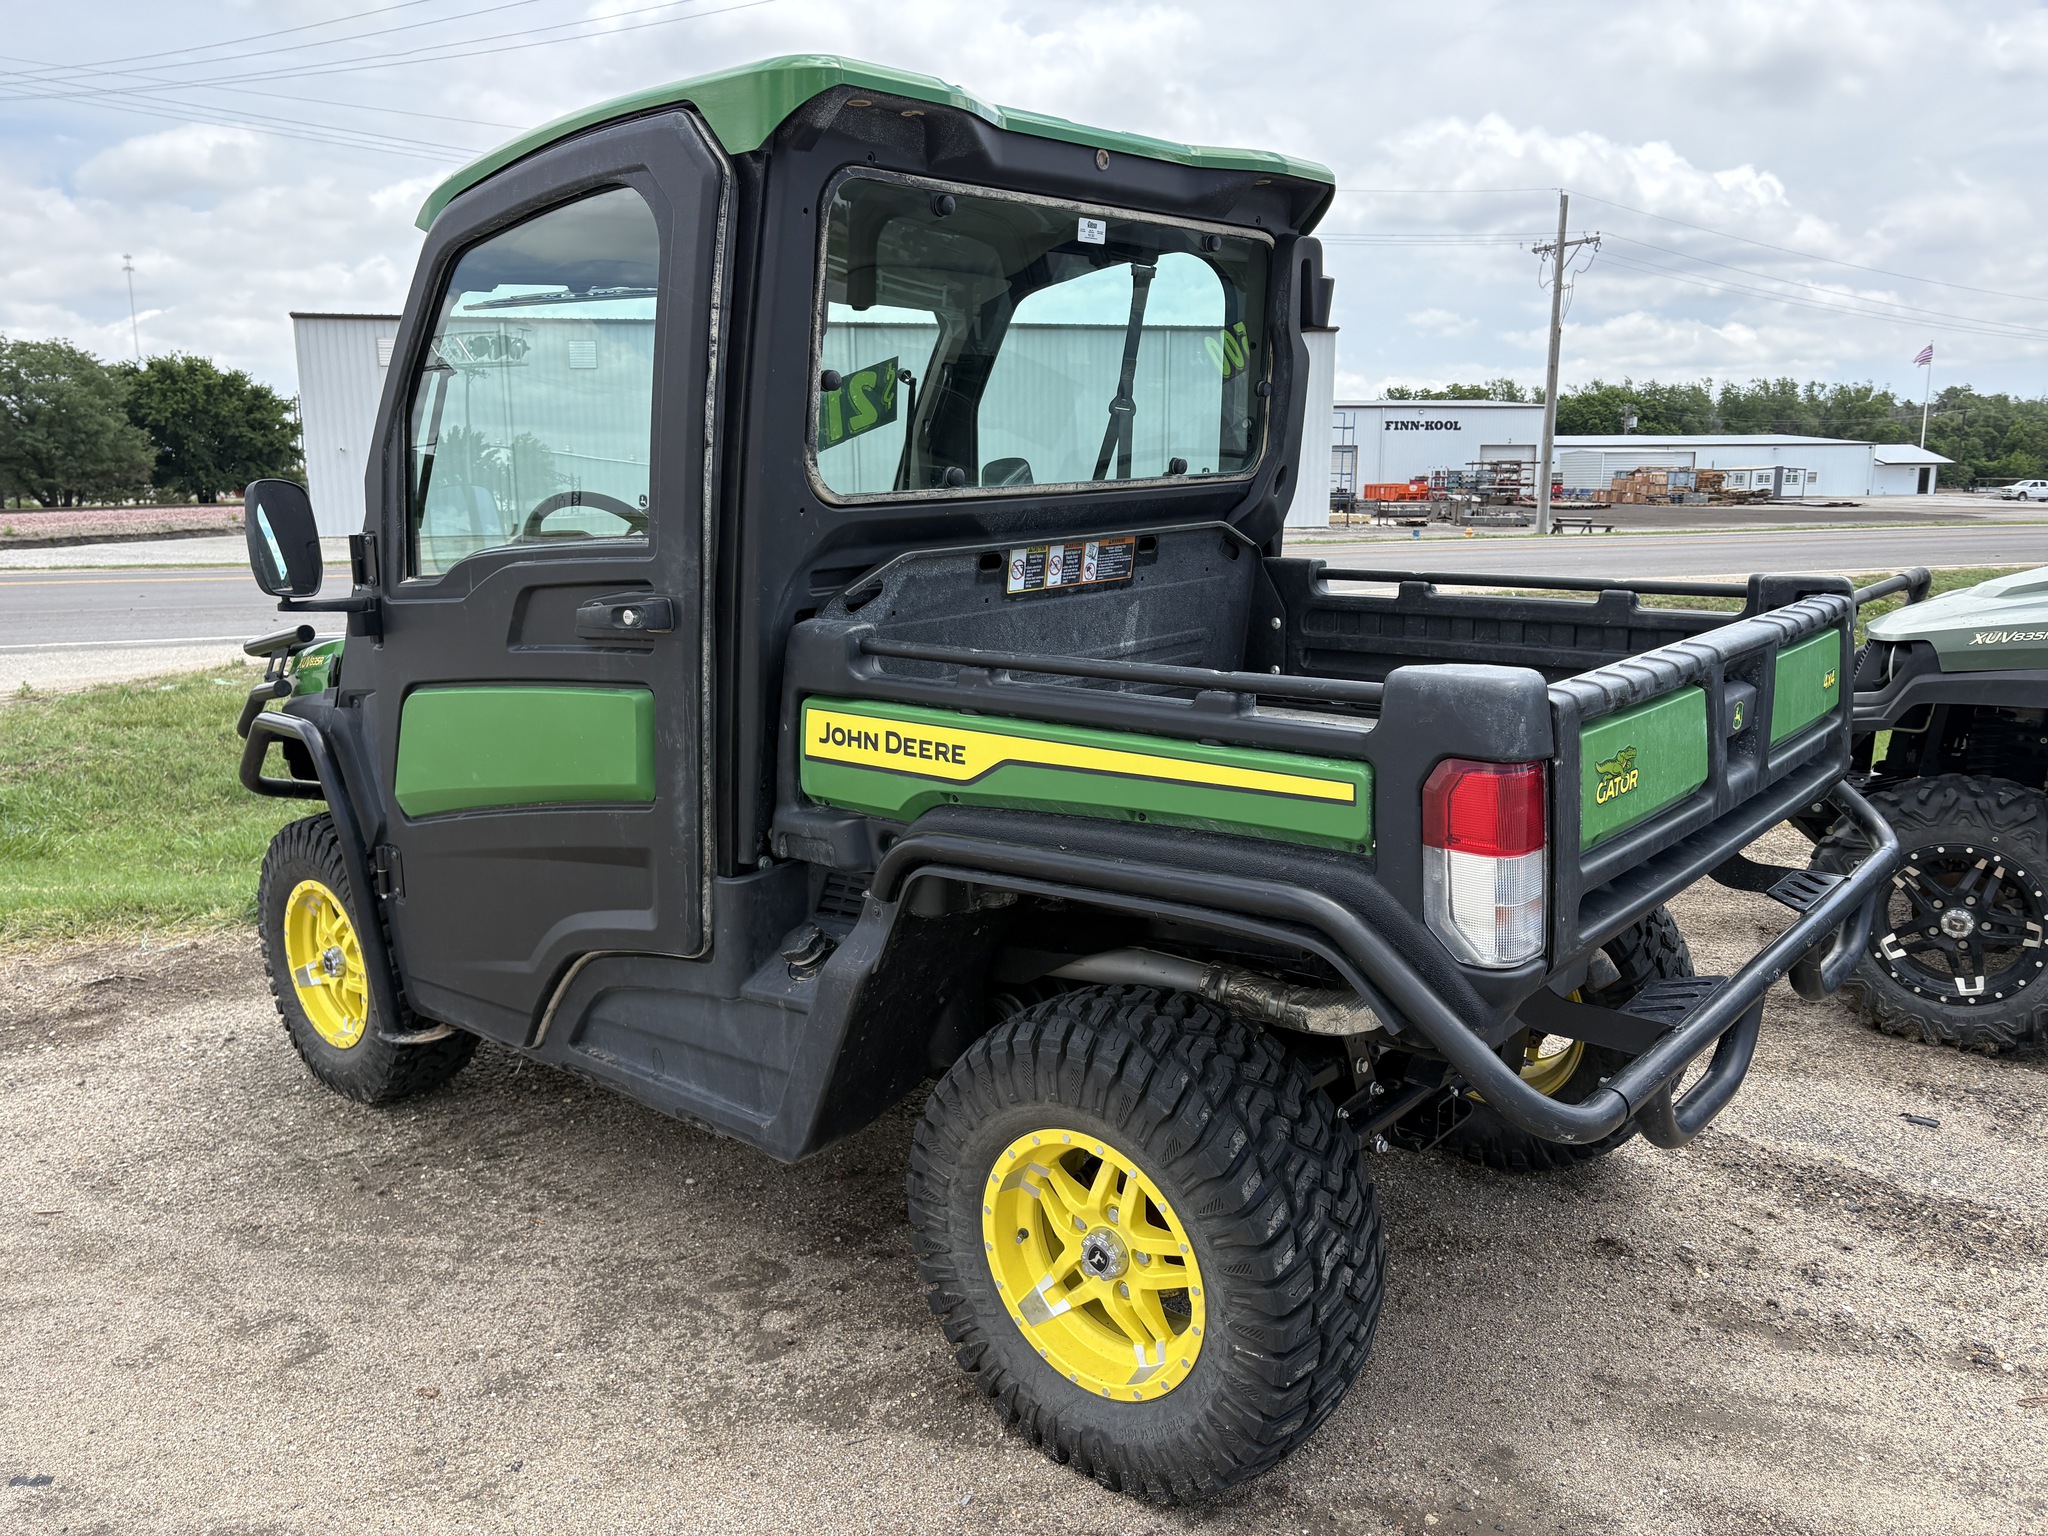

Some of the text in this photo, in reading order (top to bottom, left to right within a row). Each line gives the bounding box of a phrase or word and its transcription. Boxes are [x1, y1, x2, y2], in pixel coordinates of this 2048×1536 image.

[1385, 420, 1461, 431] FINN-KOOL
[819, 721, 966, 765] JOHN DEERE
[1596, 768, 1639, 805] GATOR
